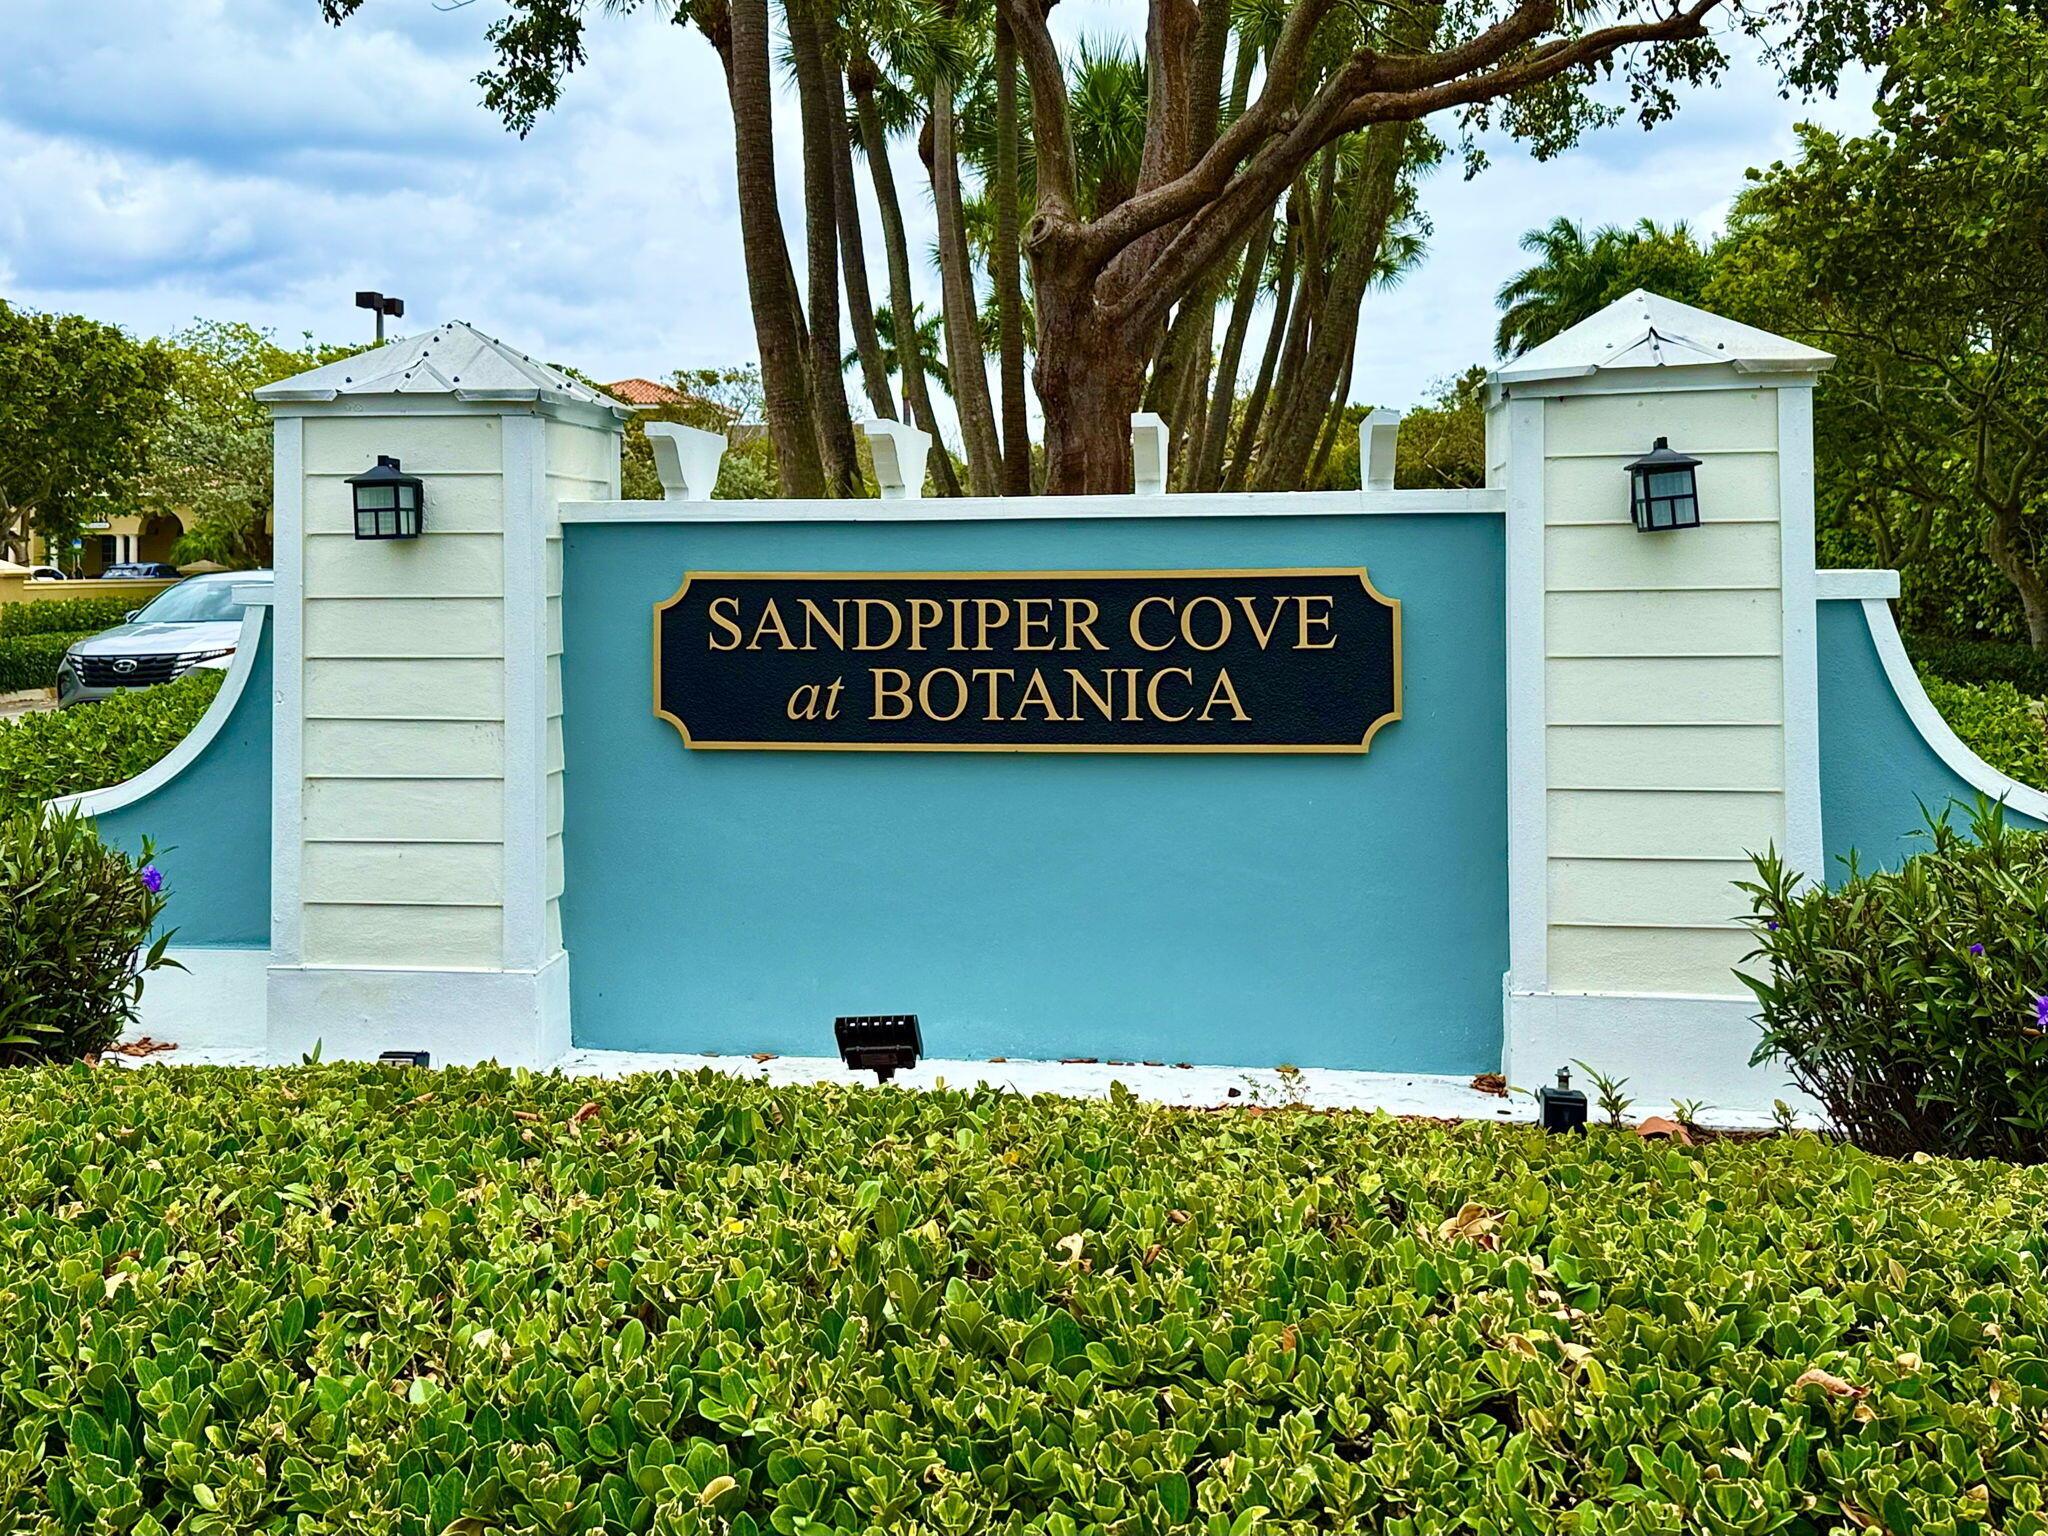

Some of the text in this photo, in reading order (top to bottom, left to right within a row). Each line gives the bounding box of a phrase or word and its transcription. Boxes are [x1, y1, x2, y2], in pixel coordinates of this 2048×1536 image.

[708, 596, 1338, 652] SANDPIPER COVE
[787, 668, 1252, 722] at BOTANICA
